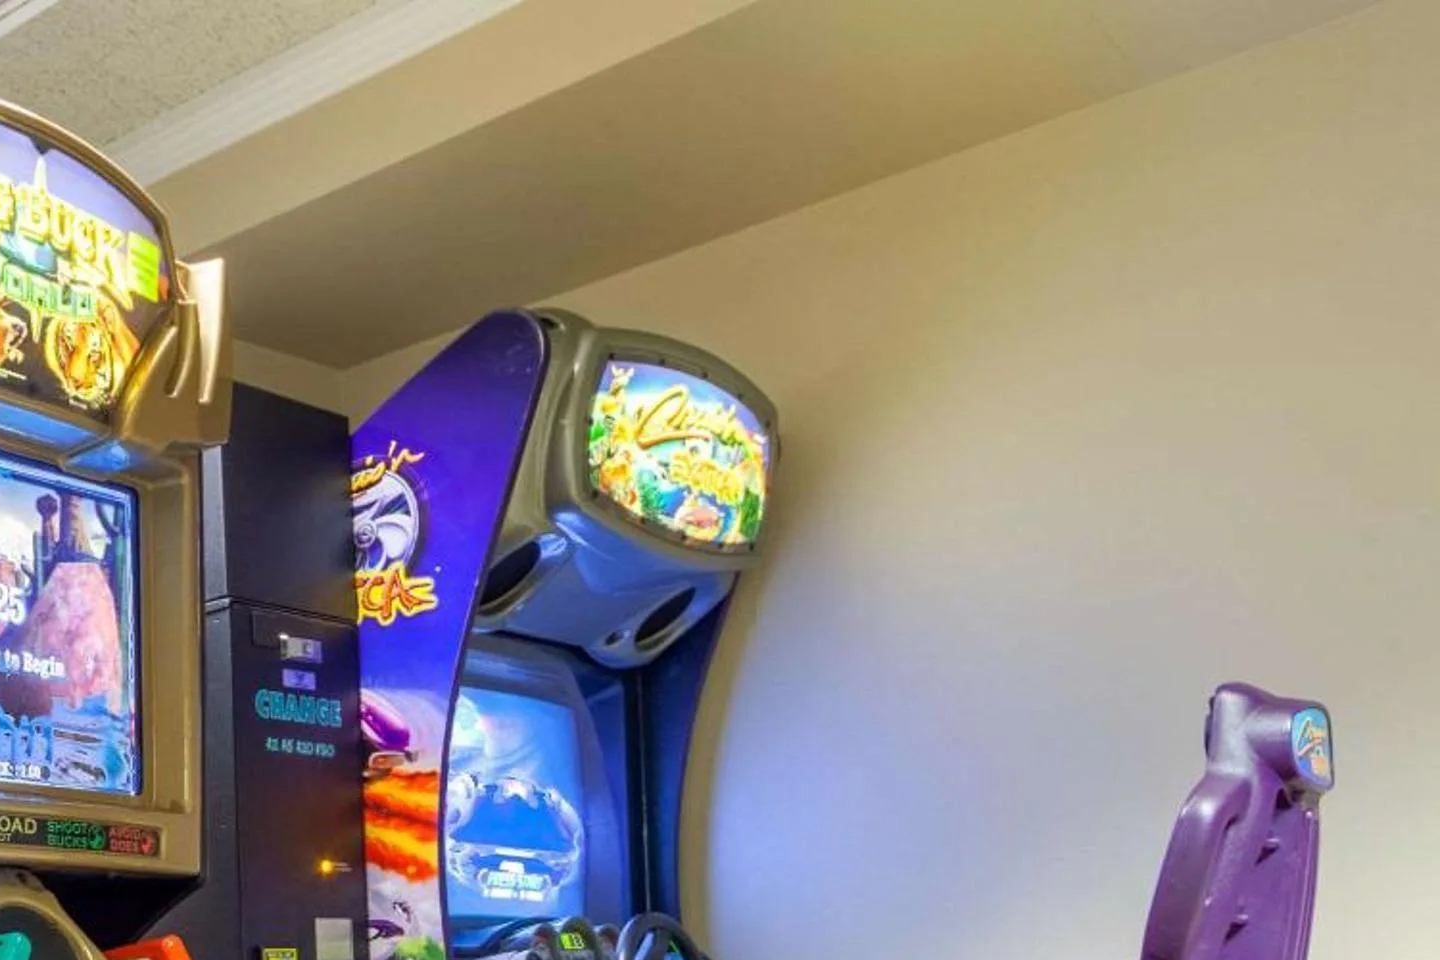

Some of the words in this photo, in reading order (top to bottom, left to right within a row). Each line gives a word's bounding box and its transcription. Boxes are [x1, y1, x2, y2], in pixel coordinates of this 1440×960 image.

[14, 181, 133, 311] BUCK
[4, 648, 20, 670] to
[23, 651, 66, 679] Begin
[255, 688, 343, 728] CHANGE
[46, 820, 88, 835] SHOOT
[46, 834, 88, 849] BUCKS
[110, 838, 140, 852] DOES
